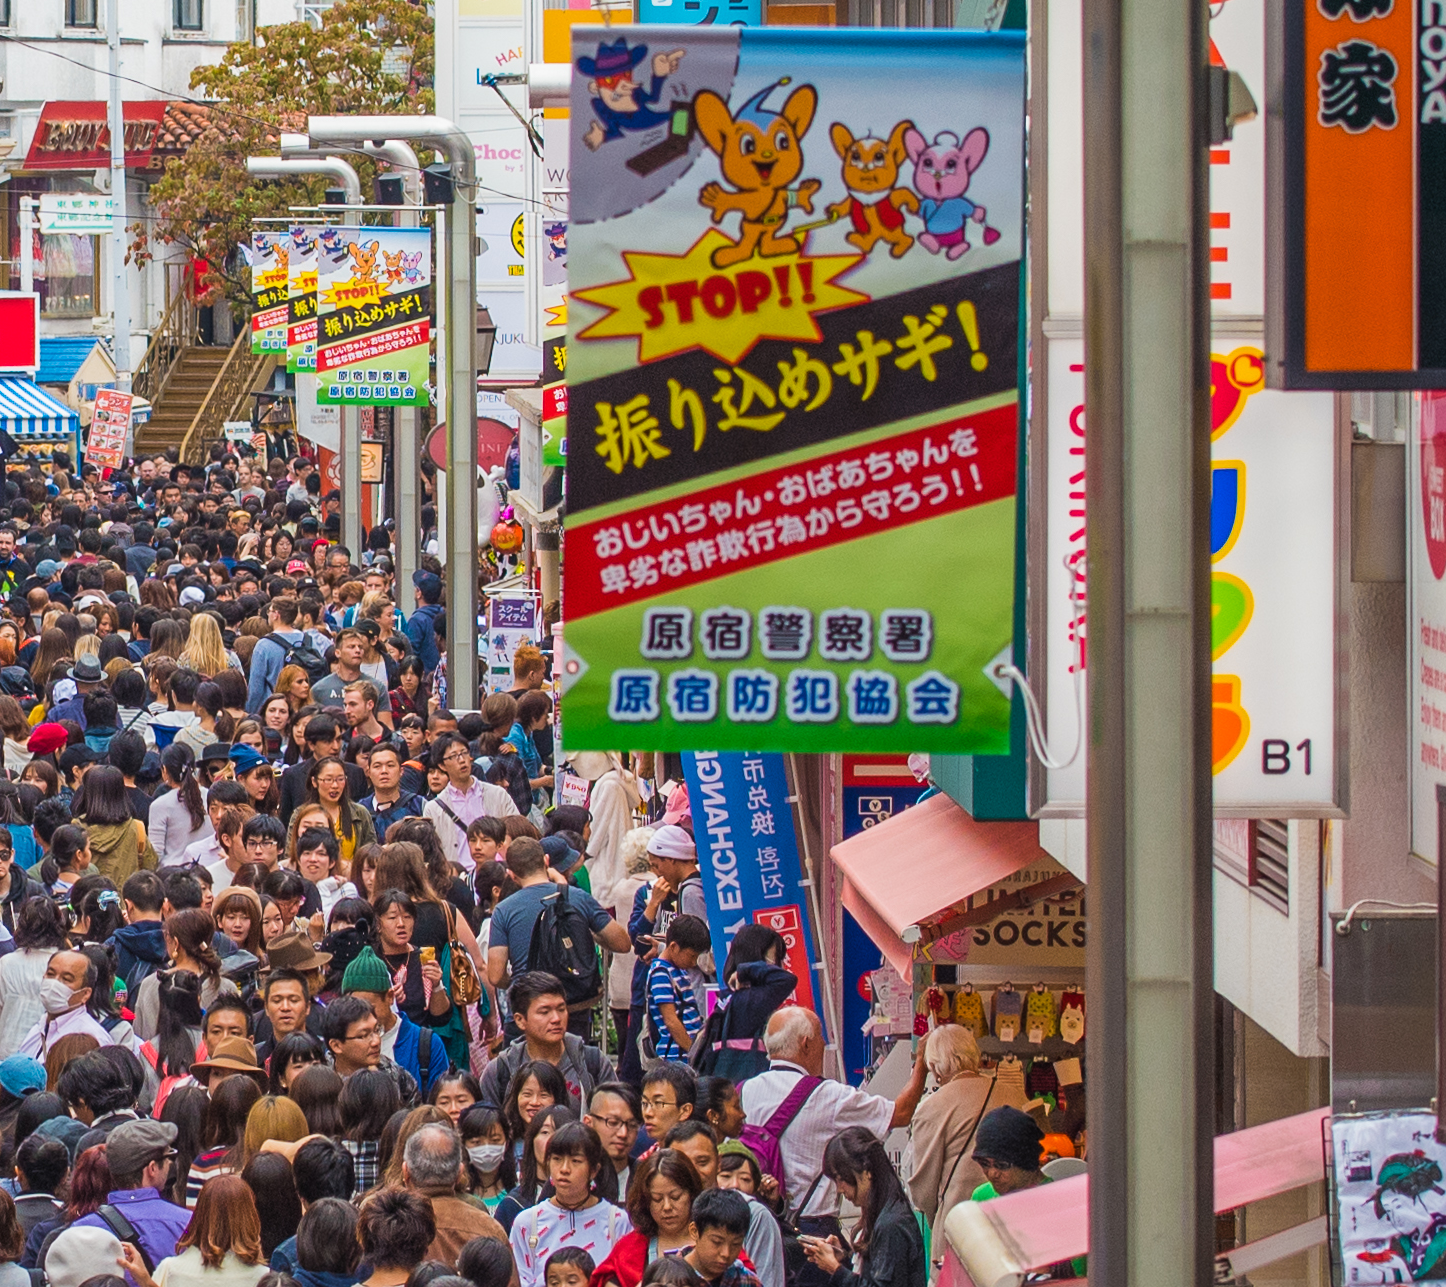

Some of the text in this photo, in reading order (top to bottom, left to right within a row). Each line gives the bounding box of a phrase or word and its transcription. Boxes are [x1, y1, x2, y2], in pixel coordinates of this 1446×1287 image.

[638, 261, 816, 330] STOP!!
[594, 300, 989, 474] 振り込めサギ!
[593, 427, 979, 559] おじいちゃん・おばあちゃんを
[645, 609, 933, 657] 原宿警察署
[613, 673, 959, 719] 原宿防犯協会
[1262, 739, 1312, 775] B1
[972, 919, 1087, 949] SOCKS
